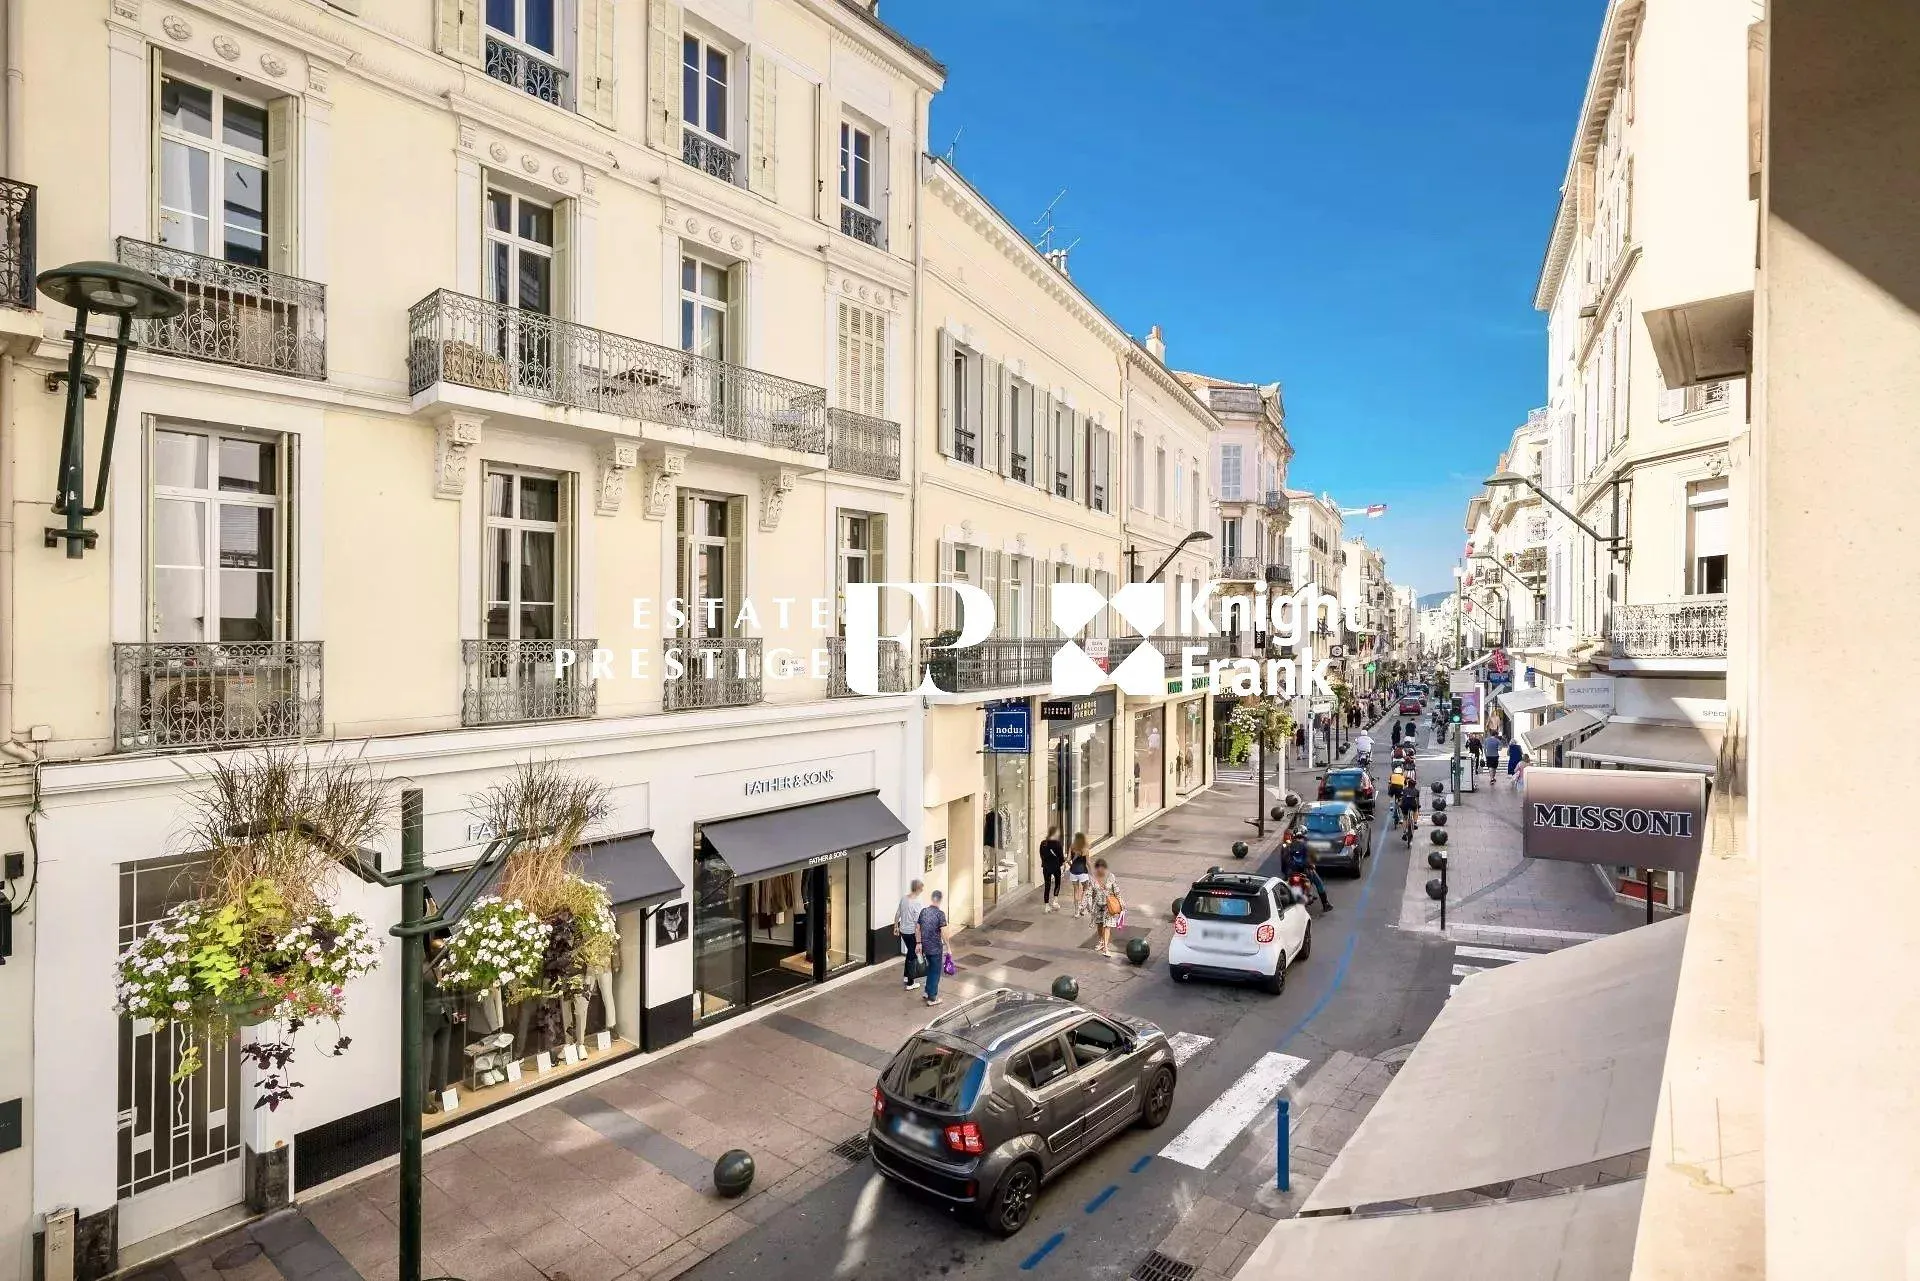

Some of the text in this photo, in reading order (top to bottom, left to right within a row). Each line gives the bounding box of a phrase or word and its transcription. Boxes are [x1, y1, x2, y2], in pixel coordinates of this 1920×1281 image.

[996, 724, 1023, 734] nodus
[745, 769, 835, 796] FATHER & SONS
[1533, 803, 1692, 838] MISSONI
[809, 855, 828, 865] FATHER
